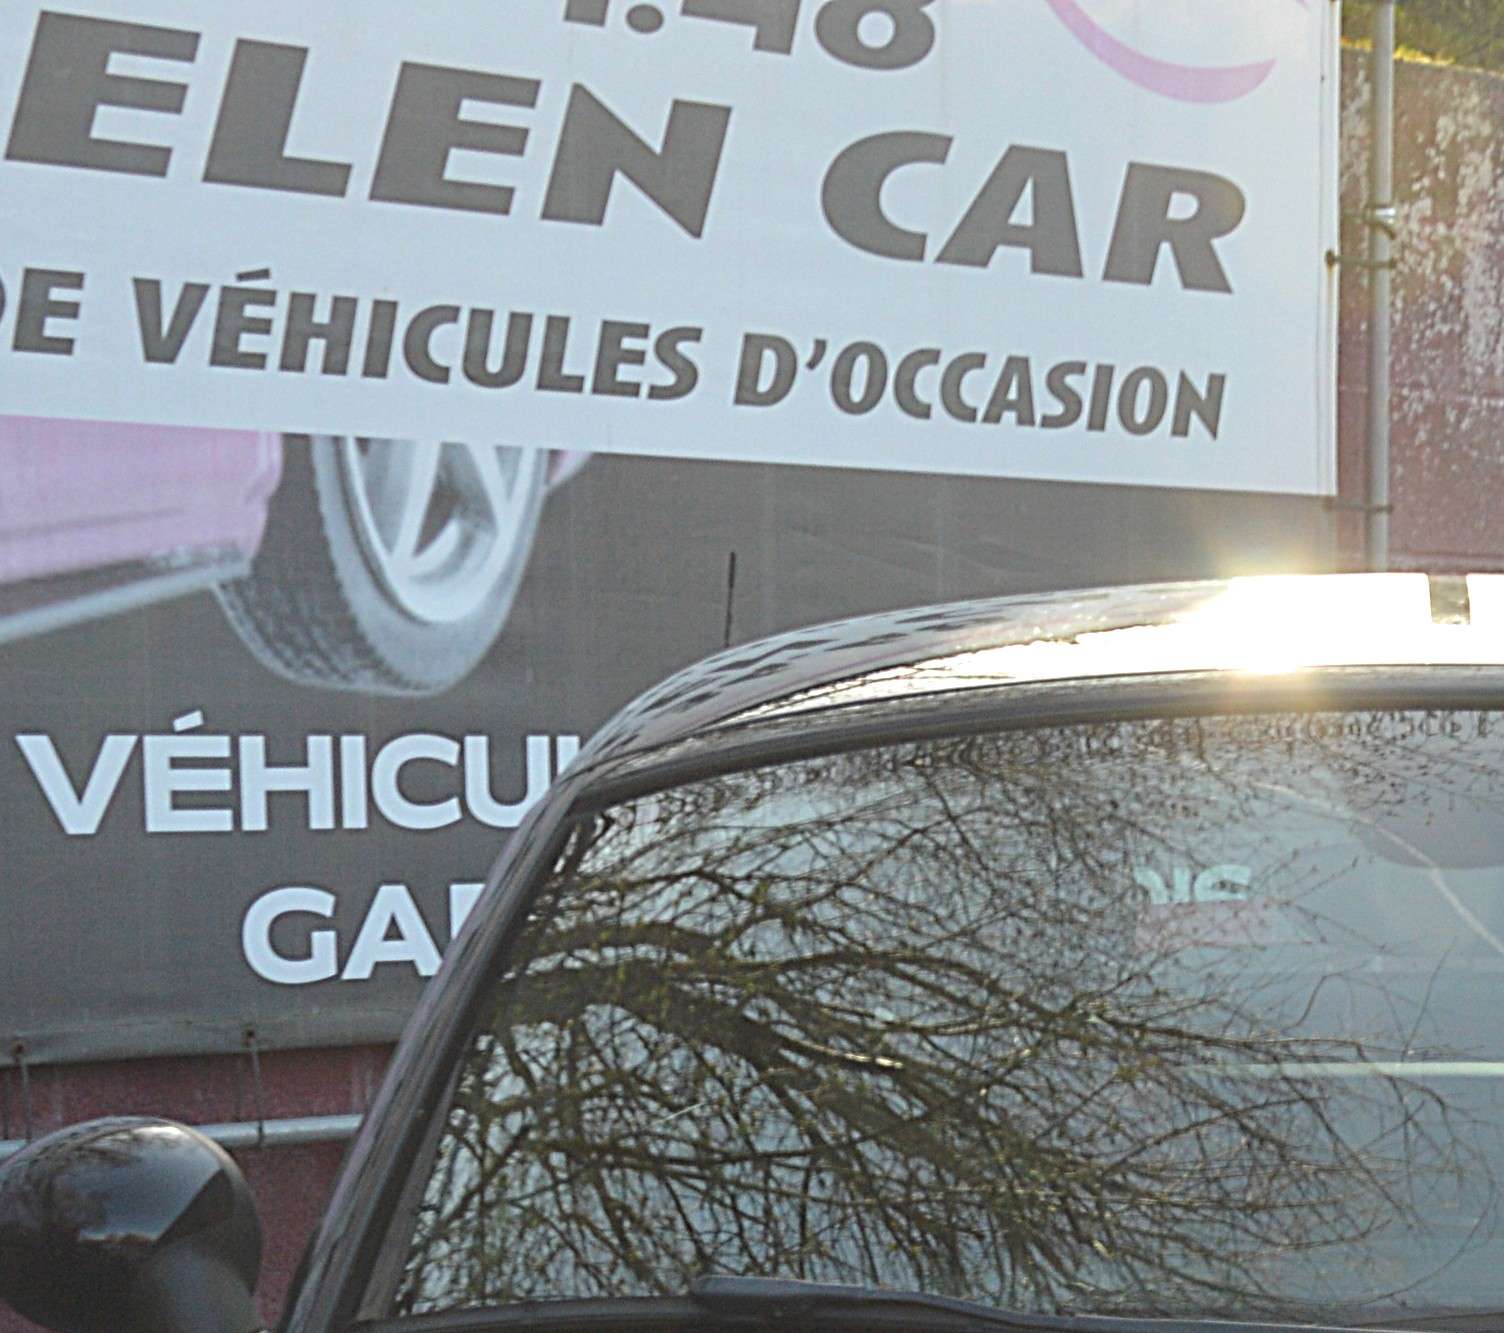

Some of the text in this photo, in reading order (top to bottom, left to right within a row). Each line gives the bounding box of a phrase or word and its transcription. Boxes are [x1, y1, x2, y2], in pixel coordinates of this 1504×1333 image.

[820, 130, 1246, 294] CAR
[132, 267, 703, 401] VÉHICULES
[242, 884, 486, 984] GA
